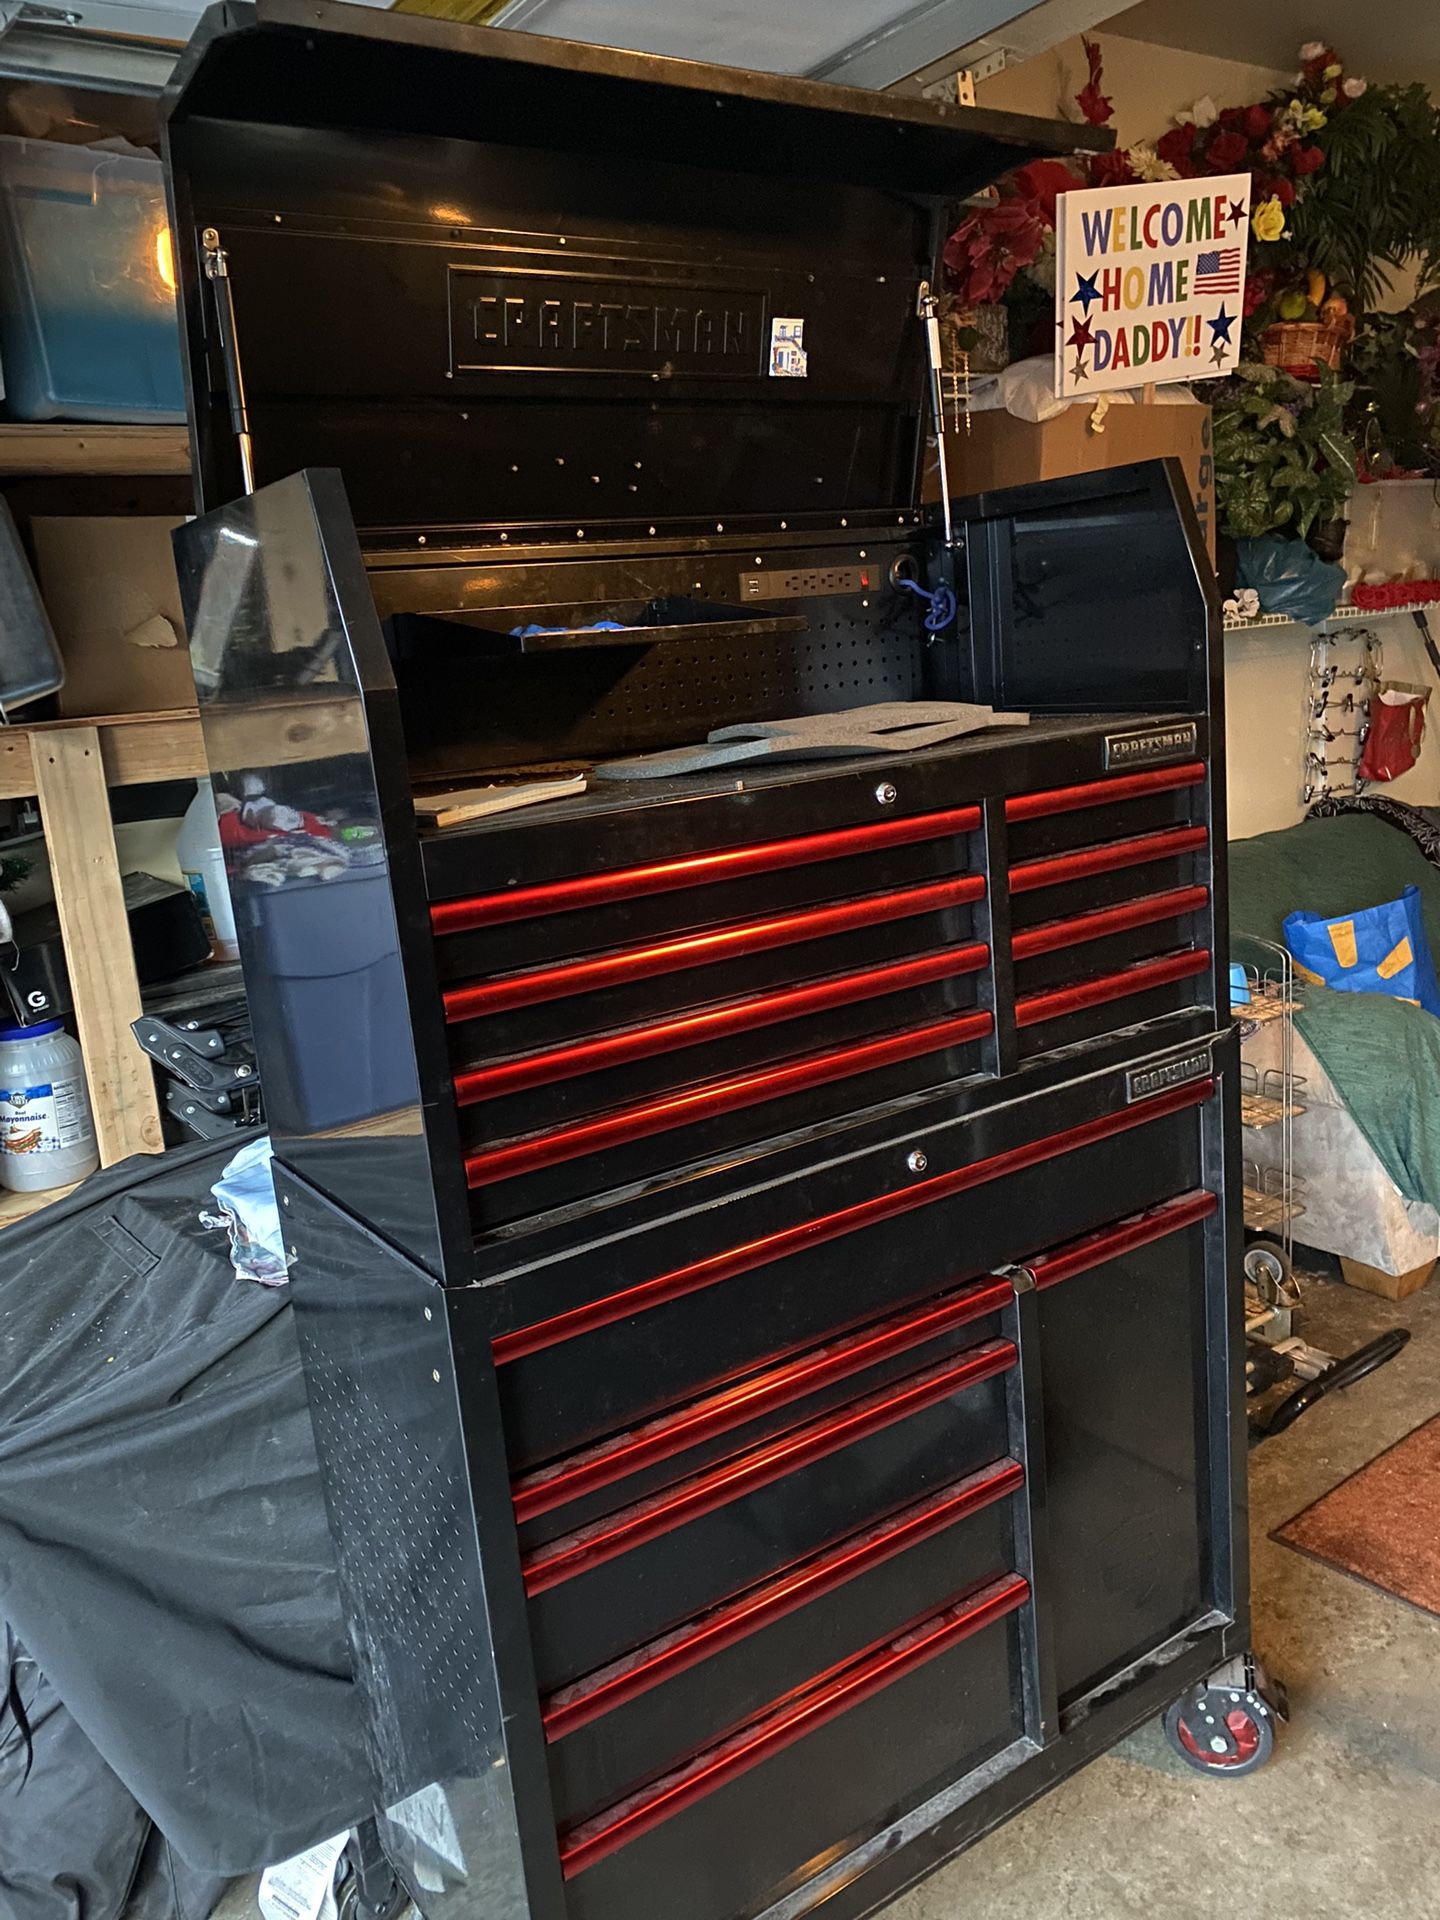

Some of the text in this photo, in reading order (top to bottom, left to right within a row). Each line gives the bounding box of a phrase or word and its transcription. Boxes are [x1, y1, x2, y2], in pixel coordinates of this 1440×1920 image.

[1081, 194, 1227, 257] WELCOME
[1101, 259, 1189, 312] HOME
[473, 296, 743, 354] CRAFTSMAN
[1093, 314, 1202, 372] DADDY!!
[1112, 731, 1192, 759] CRAFTSMAN
[27, 990, 47, 1008] G
[1132, 1052, 1209, 1094] CRAFTSMAN
[0, 1112, 47, 1124] Mayonnaise
